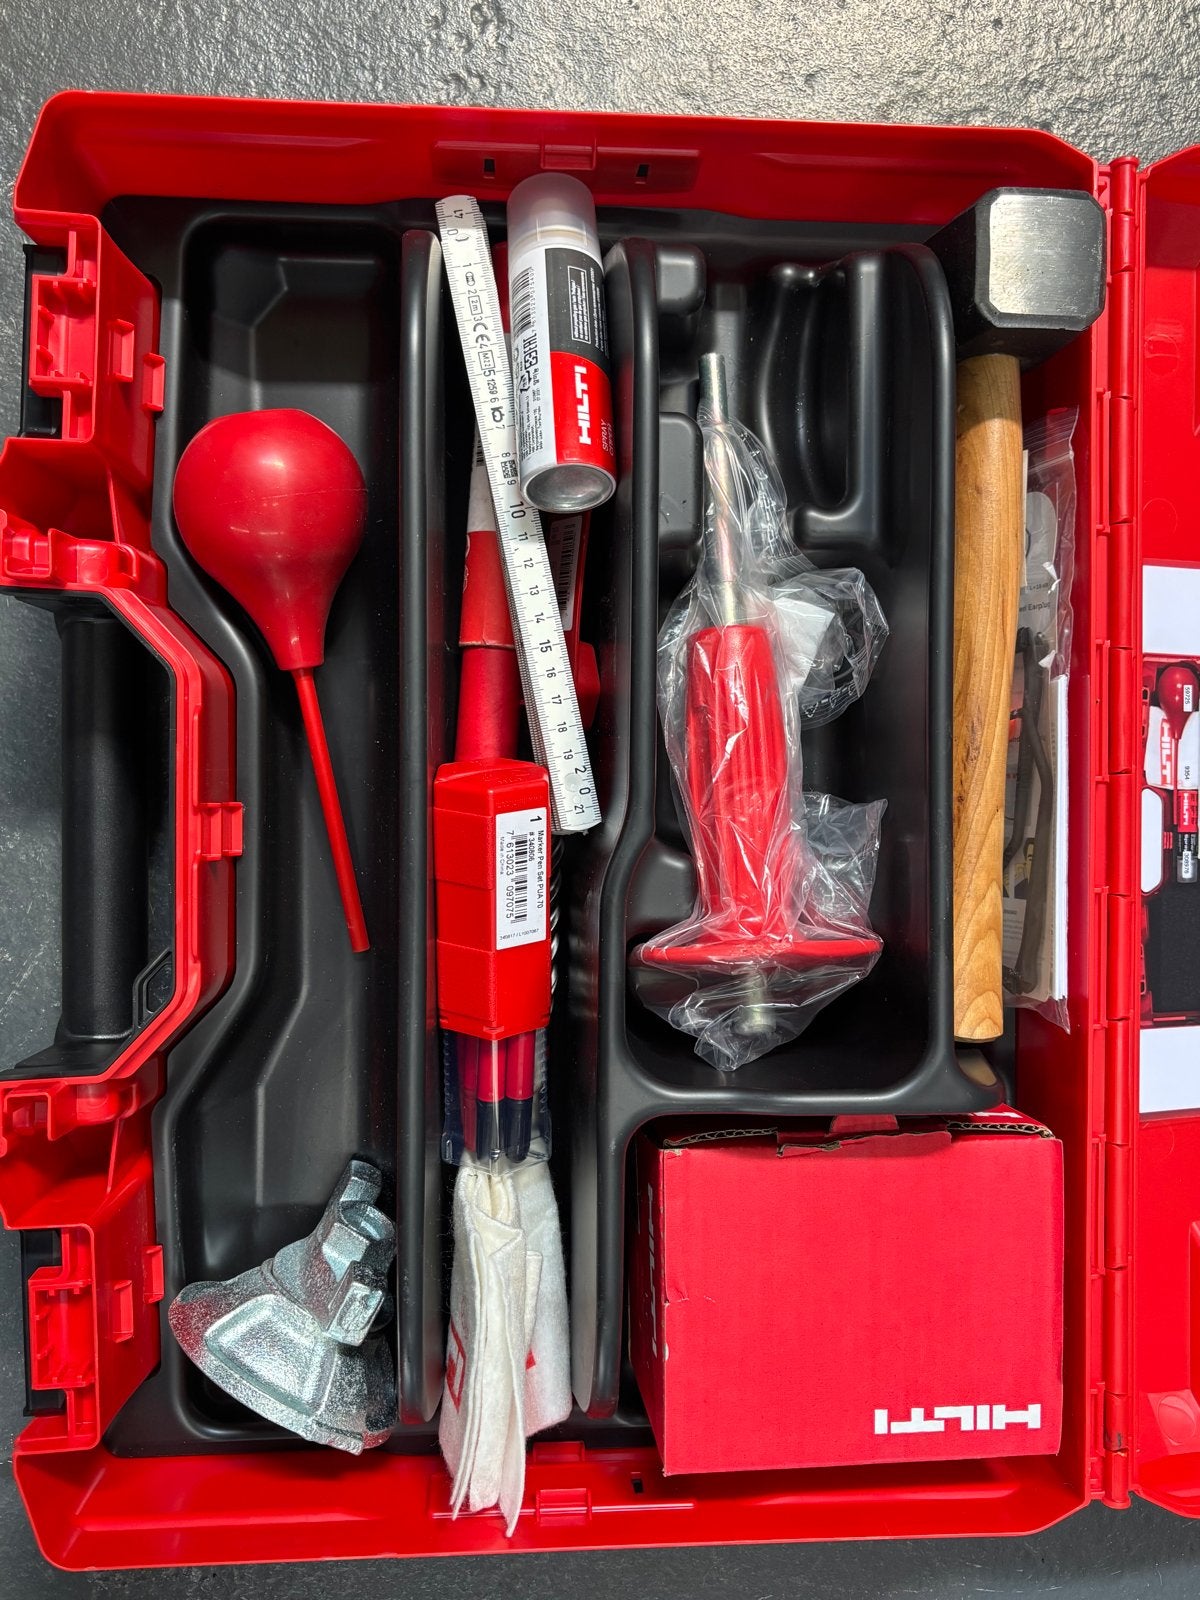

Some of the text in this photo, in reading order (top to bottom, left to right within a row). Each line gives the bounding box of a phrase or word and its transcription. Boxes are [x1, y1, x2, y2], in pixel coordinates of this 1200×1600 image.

[574, 365, 592, 445] HILTI
[600, 418, 609, 451] SPRAY
[501, 462, 510, 478] MADE
[509, 501, 526, 519] 10
[518, 531, 529, 541] 11
[523, 557, 534, 569] 12
[528, 585, 539, 596] 13
[533, 612, 545, 624] 14
[538, 639, 553, 653] 15
[545, 667, 557, 678] 16
[551, 694, 562, 705] 17
[556, 722, 568, 733] 18
[562, 749, 574, 760] 19
[573, 804, 585, 815] 21
[506, 842, 514, 876] 613023
[506, 885, 514, 919] 097075
[537, 900, 543, 909] 70
[874, 1403, 1042, 1435] HILTI
